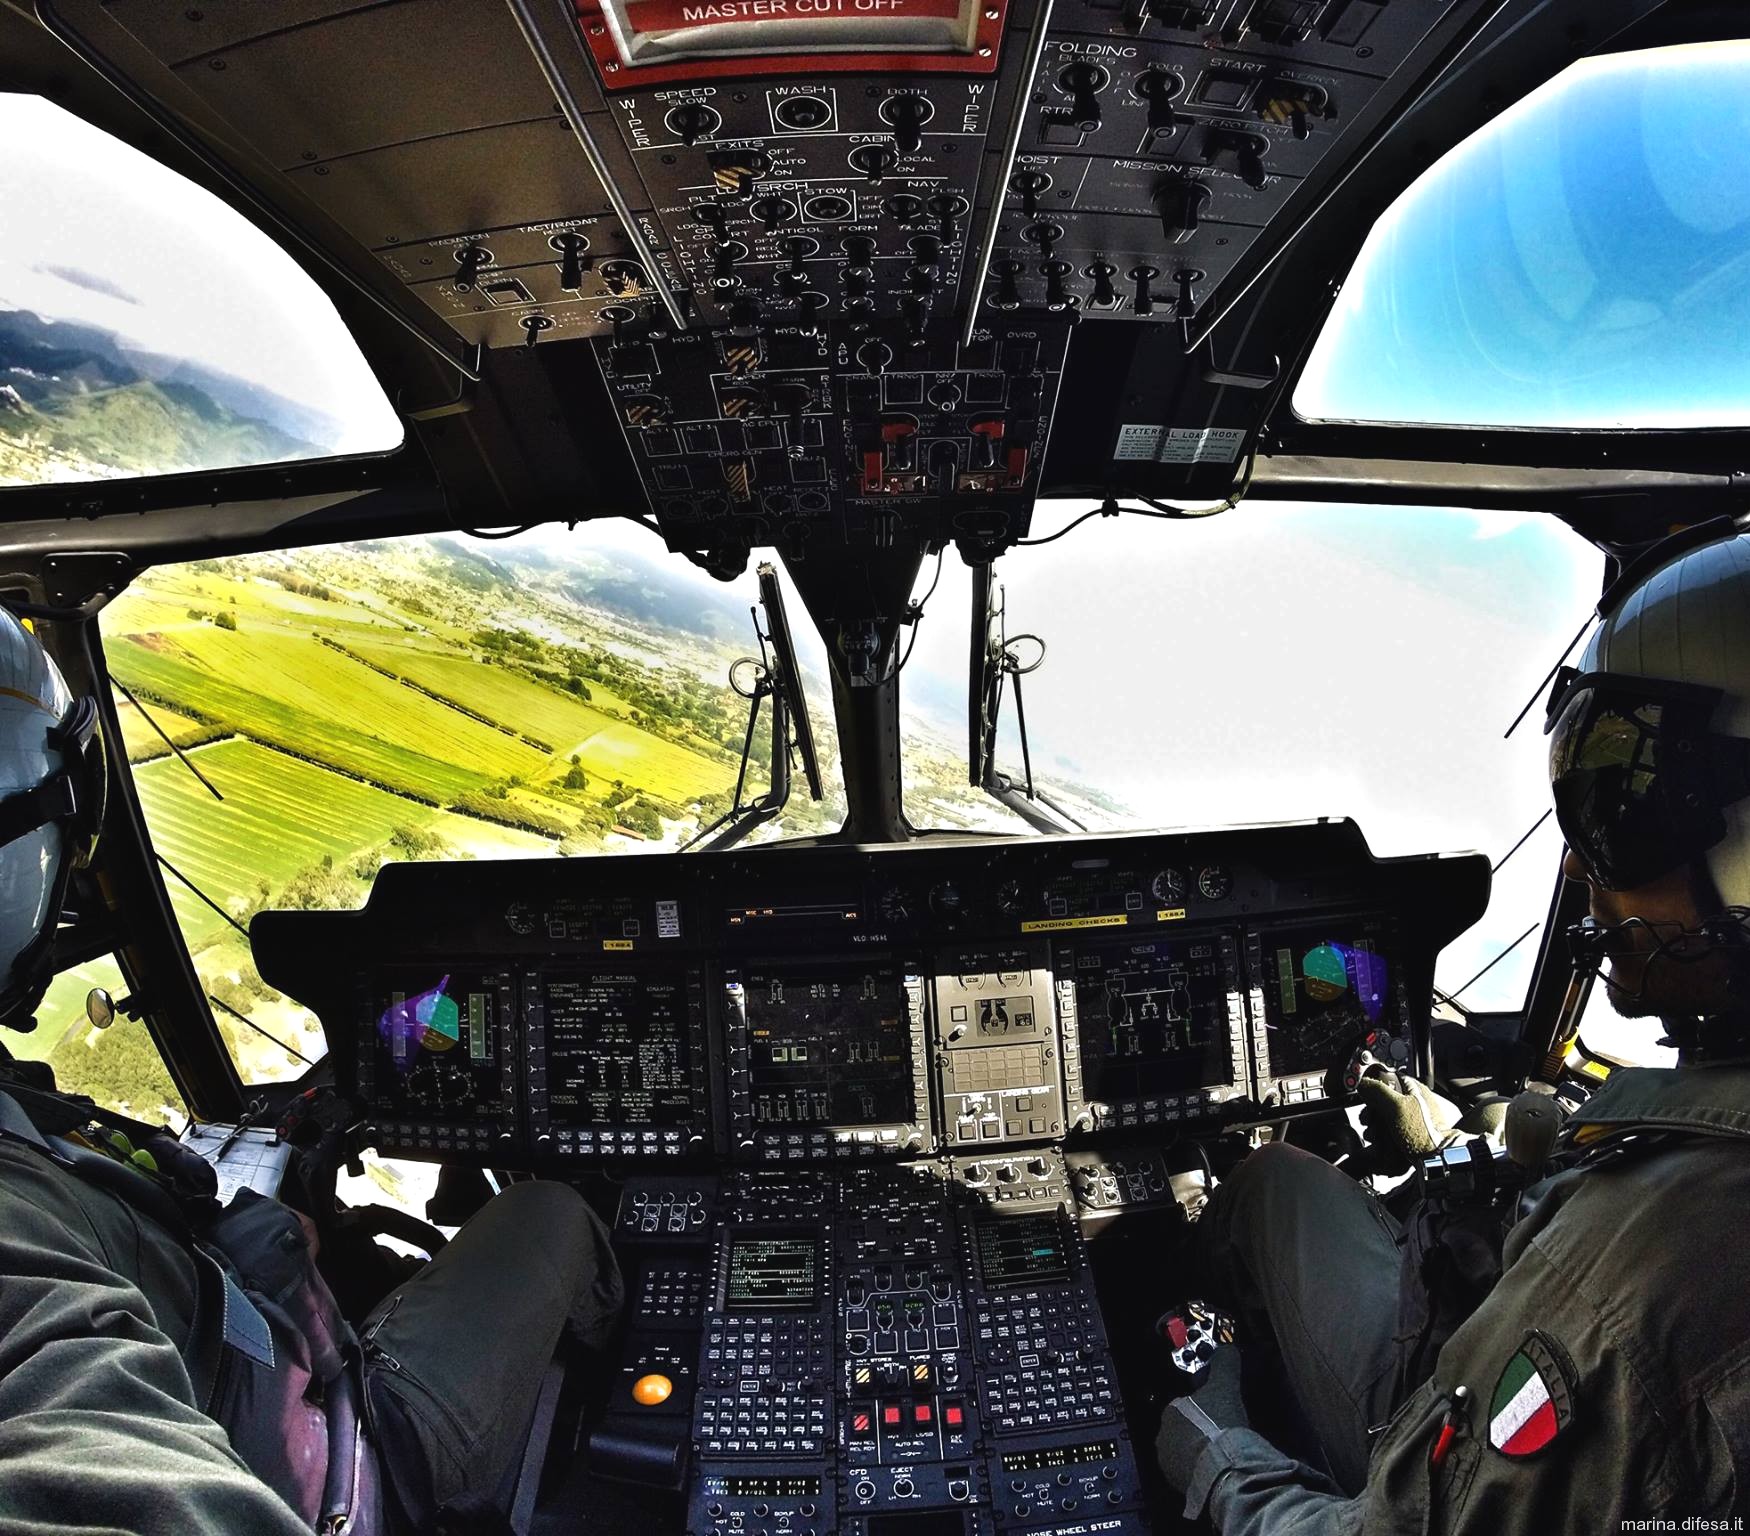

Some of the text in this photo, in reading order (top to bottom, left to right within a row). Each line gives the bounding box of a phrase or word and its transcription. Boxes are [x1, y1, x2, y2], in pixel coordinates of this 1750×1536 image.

[682, 0, 788, 21] MASTER
[795, 0, 843, 12] CUT
[1043, 41, 1138, 59] FOLDING
[1209, 57, 1267, 73] START
[654, 87, 717, 102] SPEED
[775, 85, 827, 96] WASH
[668, 97, 707, 107] SLOW
[962, 84, 985, 133] WIPER
[1038, 106, 1074, 115] RTR
[619, 99, 651, 147] WIPER
[715, 139, 765, 150] EXITS
[848, 135, 896, 144] CABIN
[772, 157, 807, 167] AUTO
[1014, 155, 1062, 165] HOIST
[1112, 160, 1183, 173] MISSION
[774, 168, 794, 177] ON
[715, 182, 808, 196] LD/SRCH
[907, 180, 940, 188] NAV
[804, 187, 848, 196] STOW
[688, 195, 717, 203] PLT
[519, 217, 598, 234] TACT/RADAR
[765, 226, 824, 236] NTICOL
[775, 327, 798, 335] HYD
[816, 333, 828, 356] HYD
[838, 342, 849, 365] APU
[1125, 428, 1177, 439] EXTERNAL
[1211, 431, 1240, 439] HOOK
[1028, 916, 1120, 930] LANDING CHECKS
[1527, 1341, 1570, 1421] ITALIA
[849, 1468, 868, 1476] CFD
[1090, 1520, 1122, 1532] STEER
